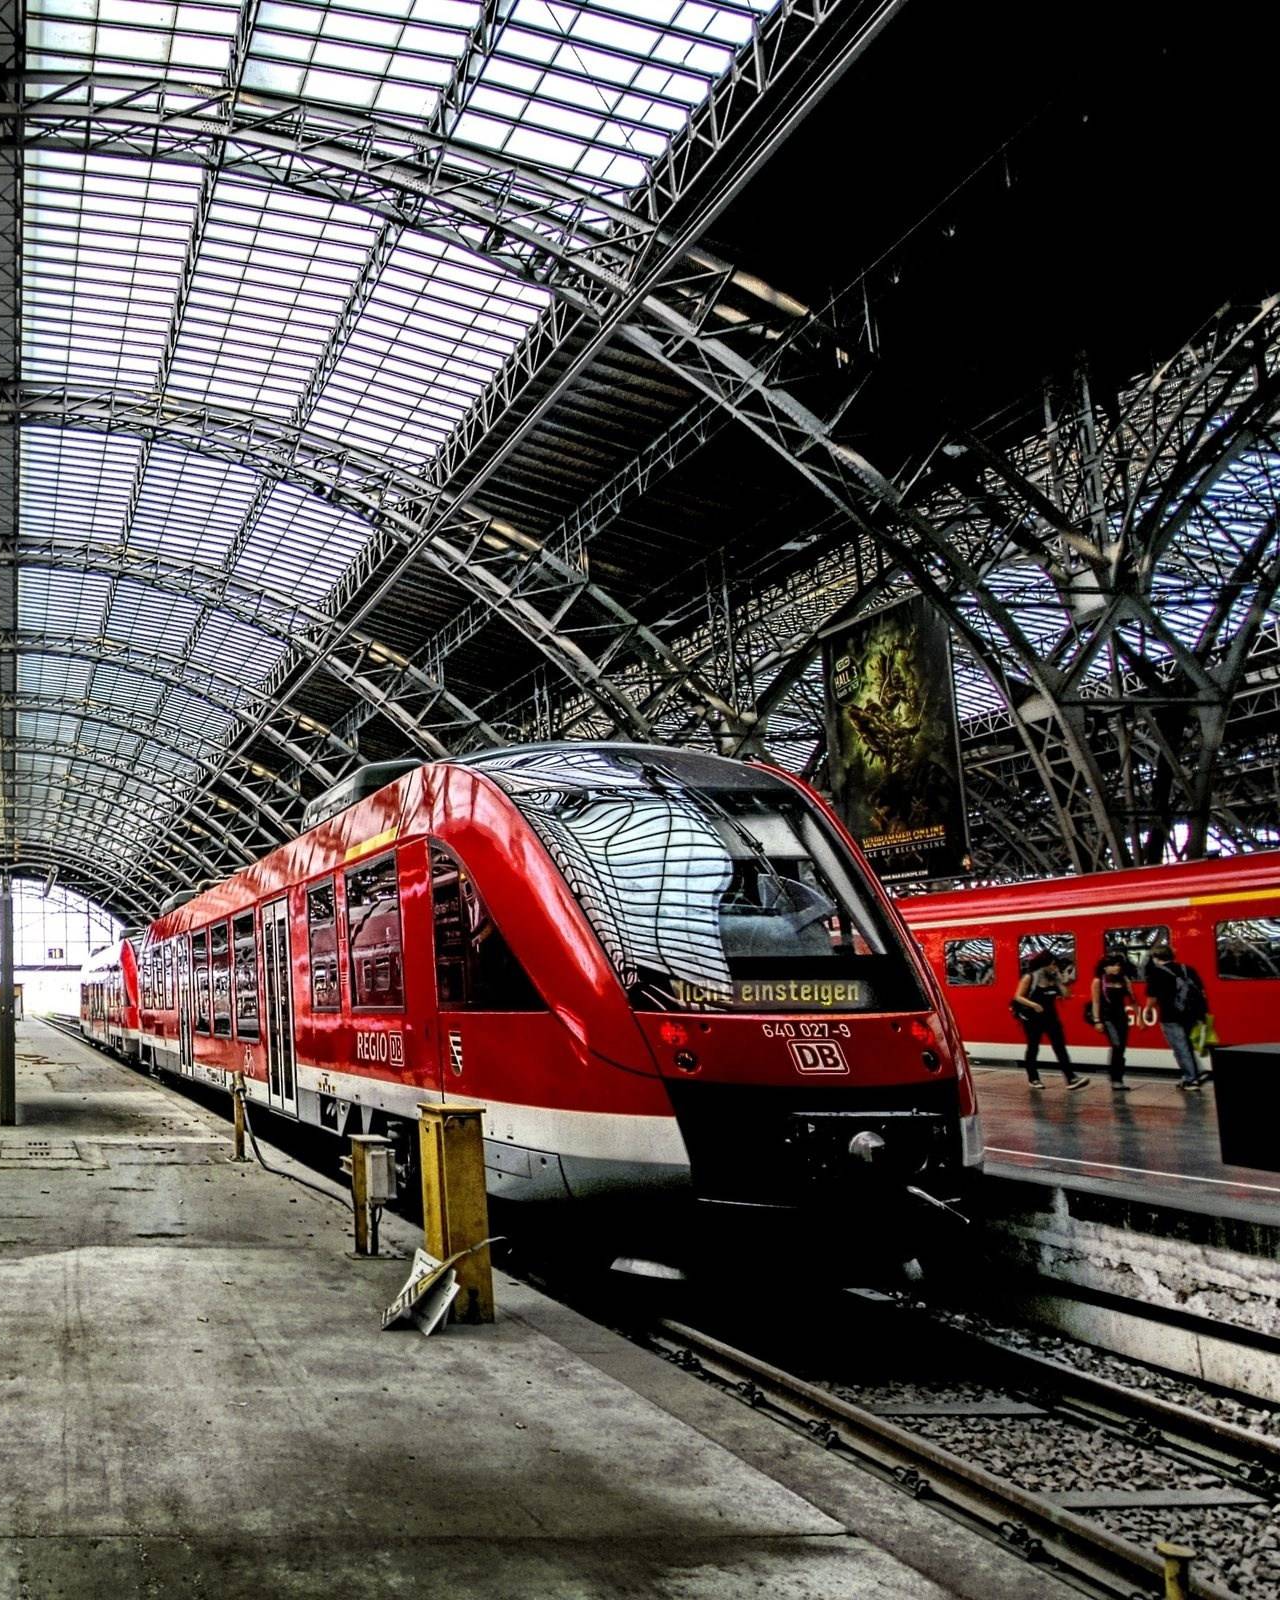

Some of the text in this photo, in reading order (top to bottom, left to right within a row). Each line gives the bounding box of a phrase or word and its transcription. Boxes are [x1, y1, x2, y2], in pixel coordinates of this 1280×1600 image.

[834, 670, 851, 689] HALL
[912, 825, 945, 841] ONLINE
[895, 840, 946, 855] RECKONING
[741, 981, 859, 1006] einsteigen
[1124, 1005, 1158, 1027] GIO
[762, 1023, 851, 1038] 640 027-9
[357, 1031, 403, 1062] REGIO DB
[794, 1043, 843, 1070] DB
